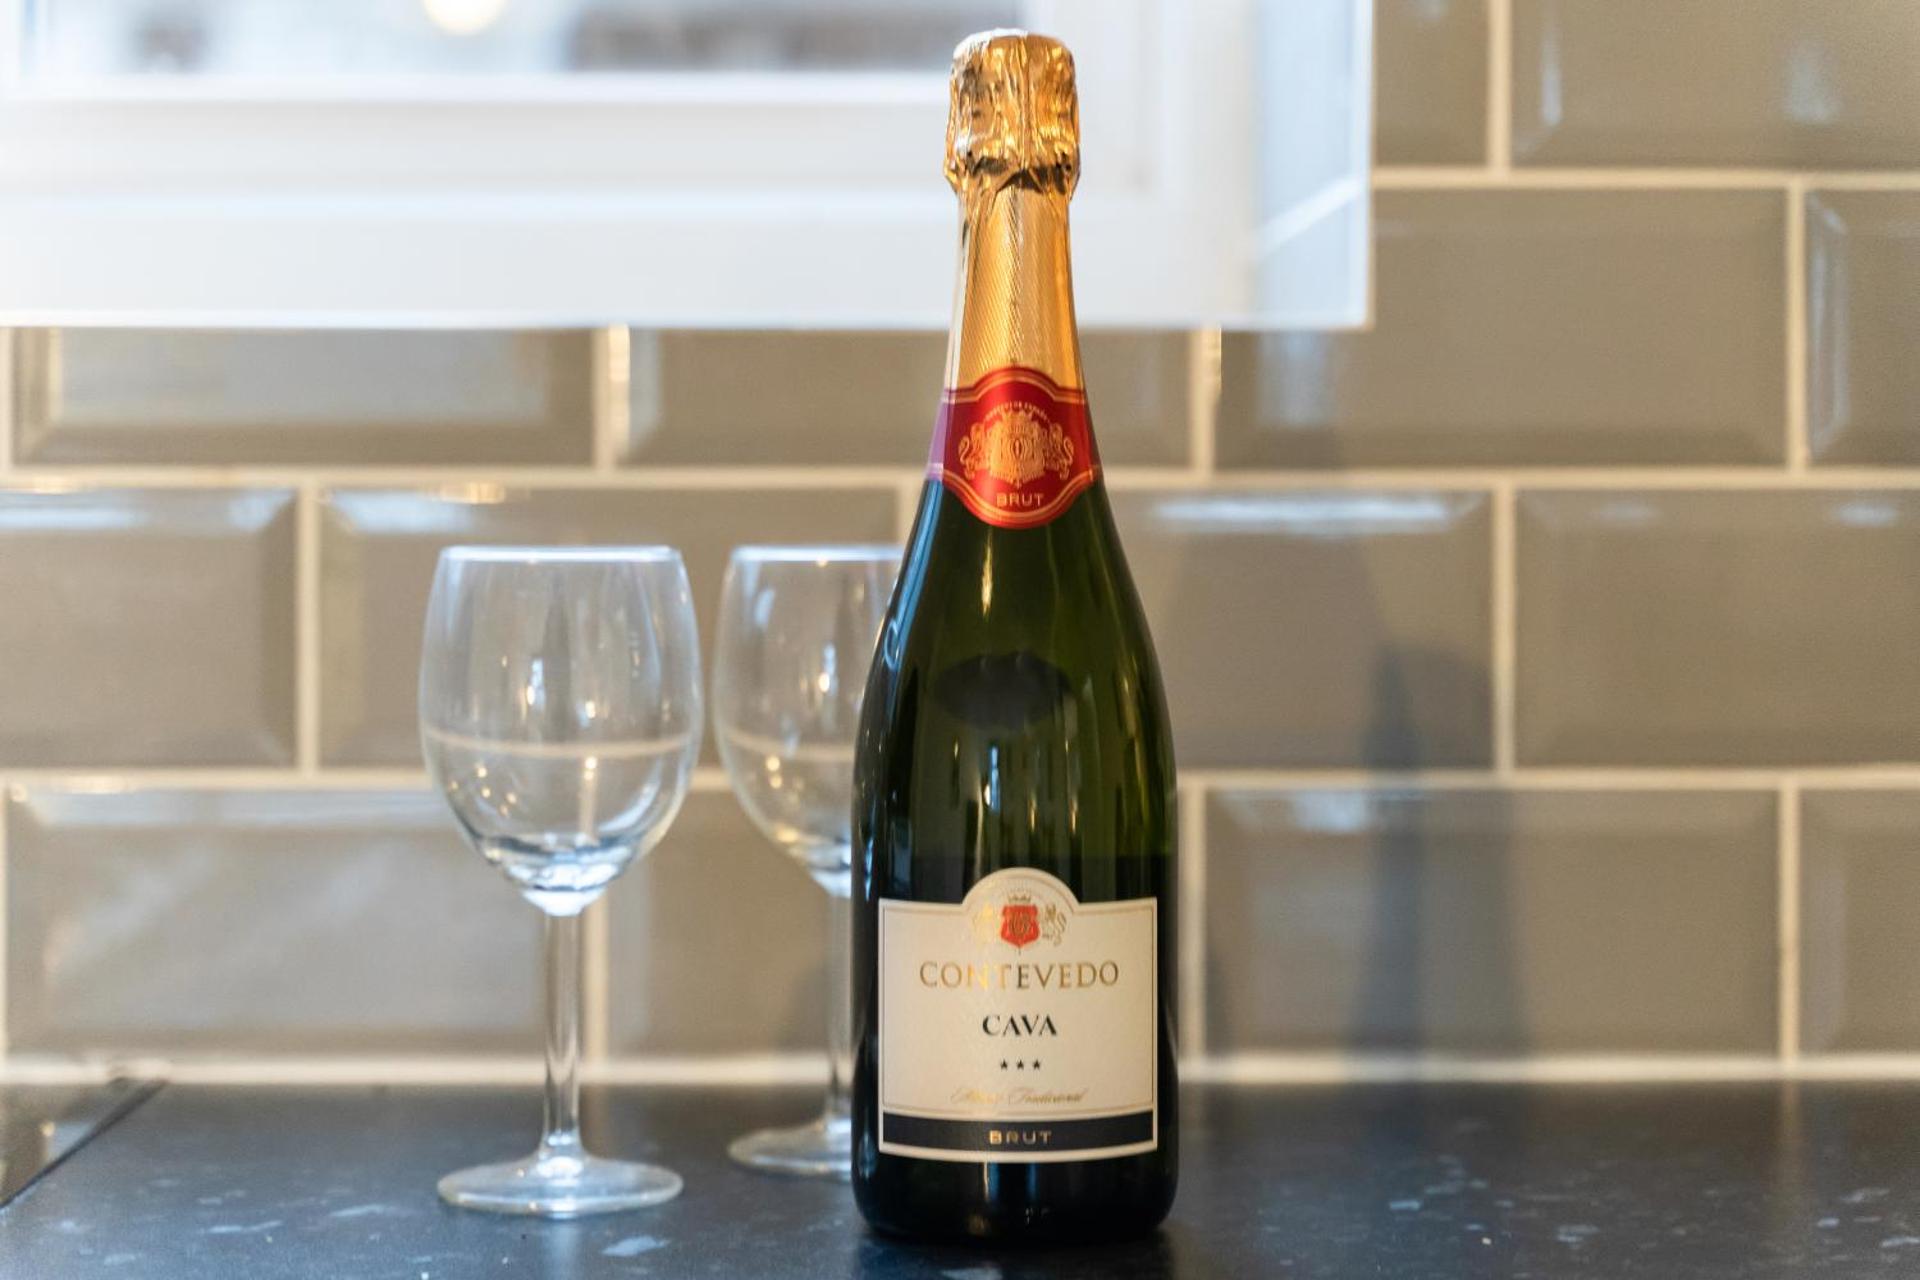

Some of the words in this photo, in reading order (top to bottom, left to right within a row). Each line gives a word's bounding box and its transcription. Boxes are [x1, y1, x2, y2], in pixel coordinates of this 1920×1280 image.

[996, 493, 1044, 507] BRUT
[919, 960, 1119, 992] CONTEVEDO
[981, 1013, 1058, 1037] CAVA
[988, 1129, 1053, 1146] BRUT
